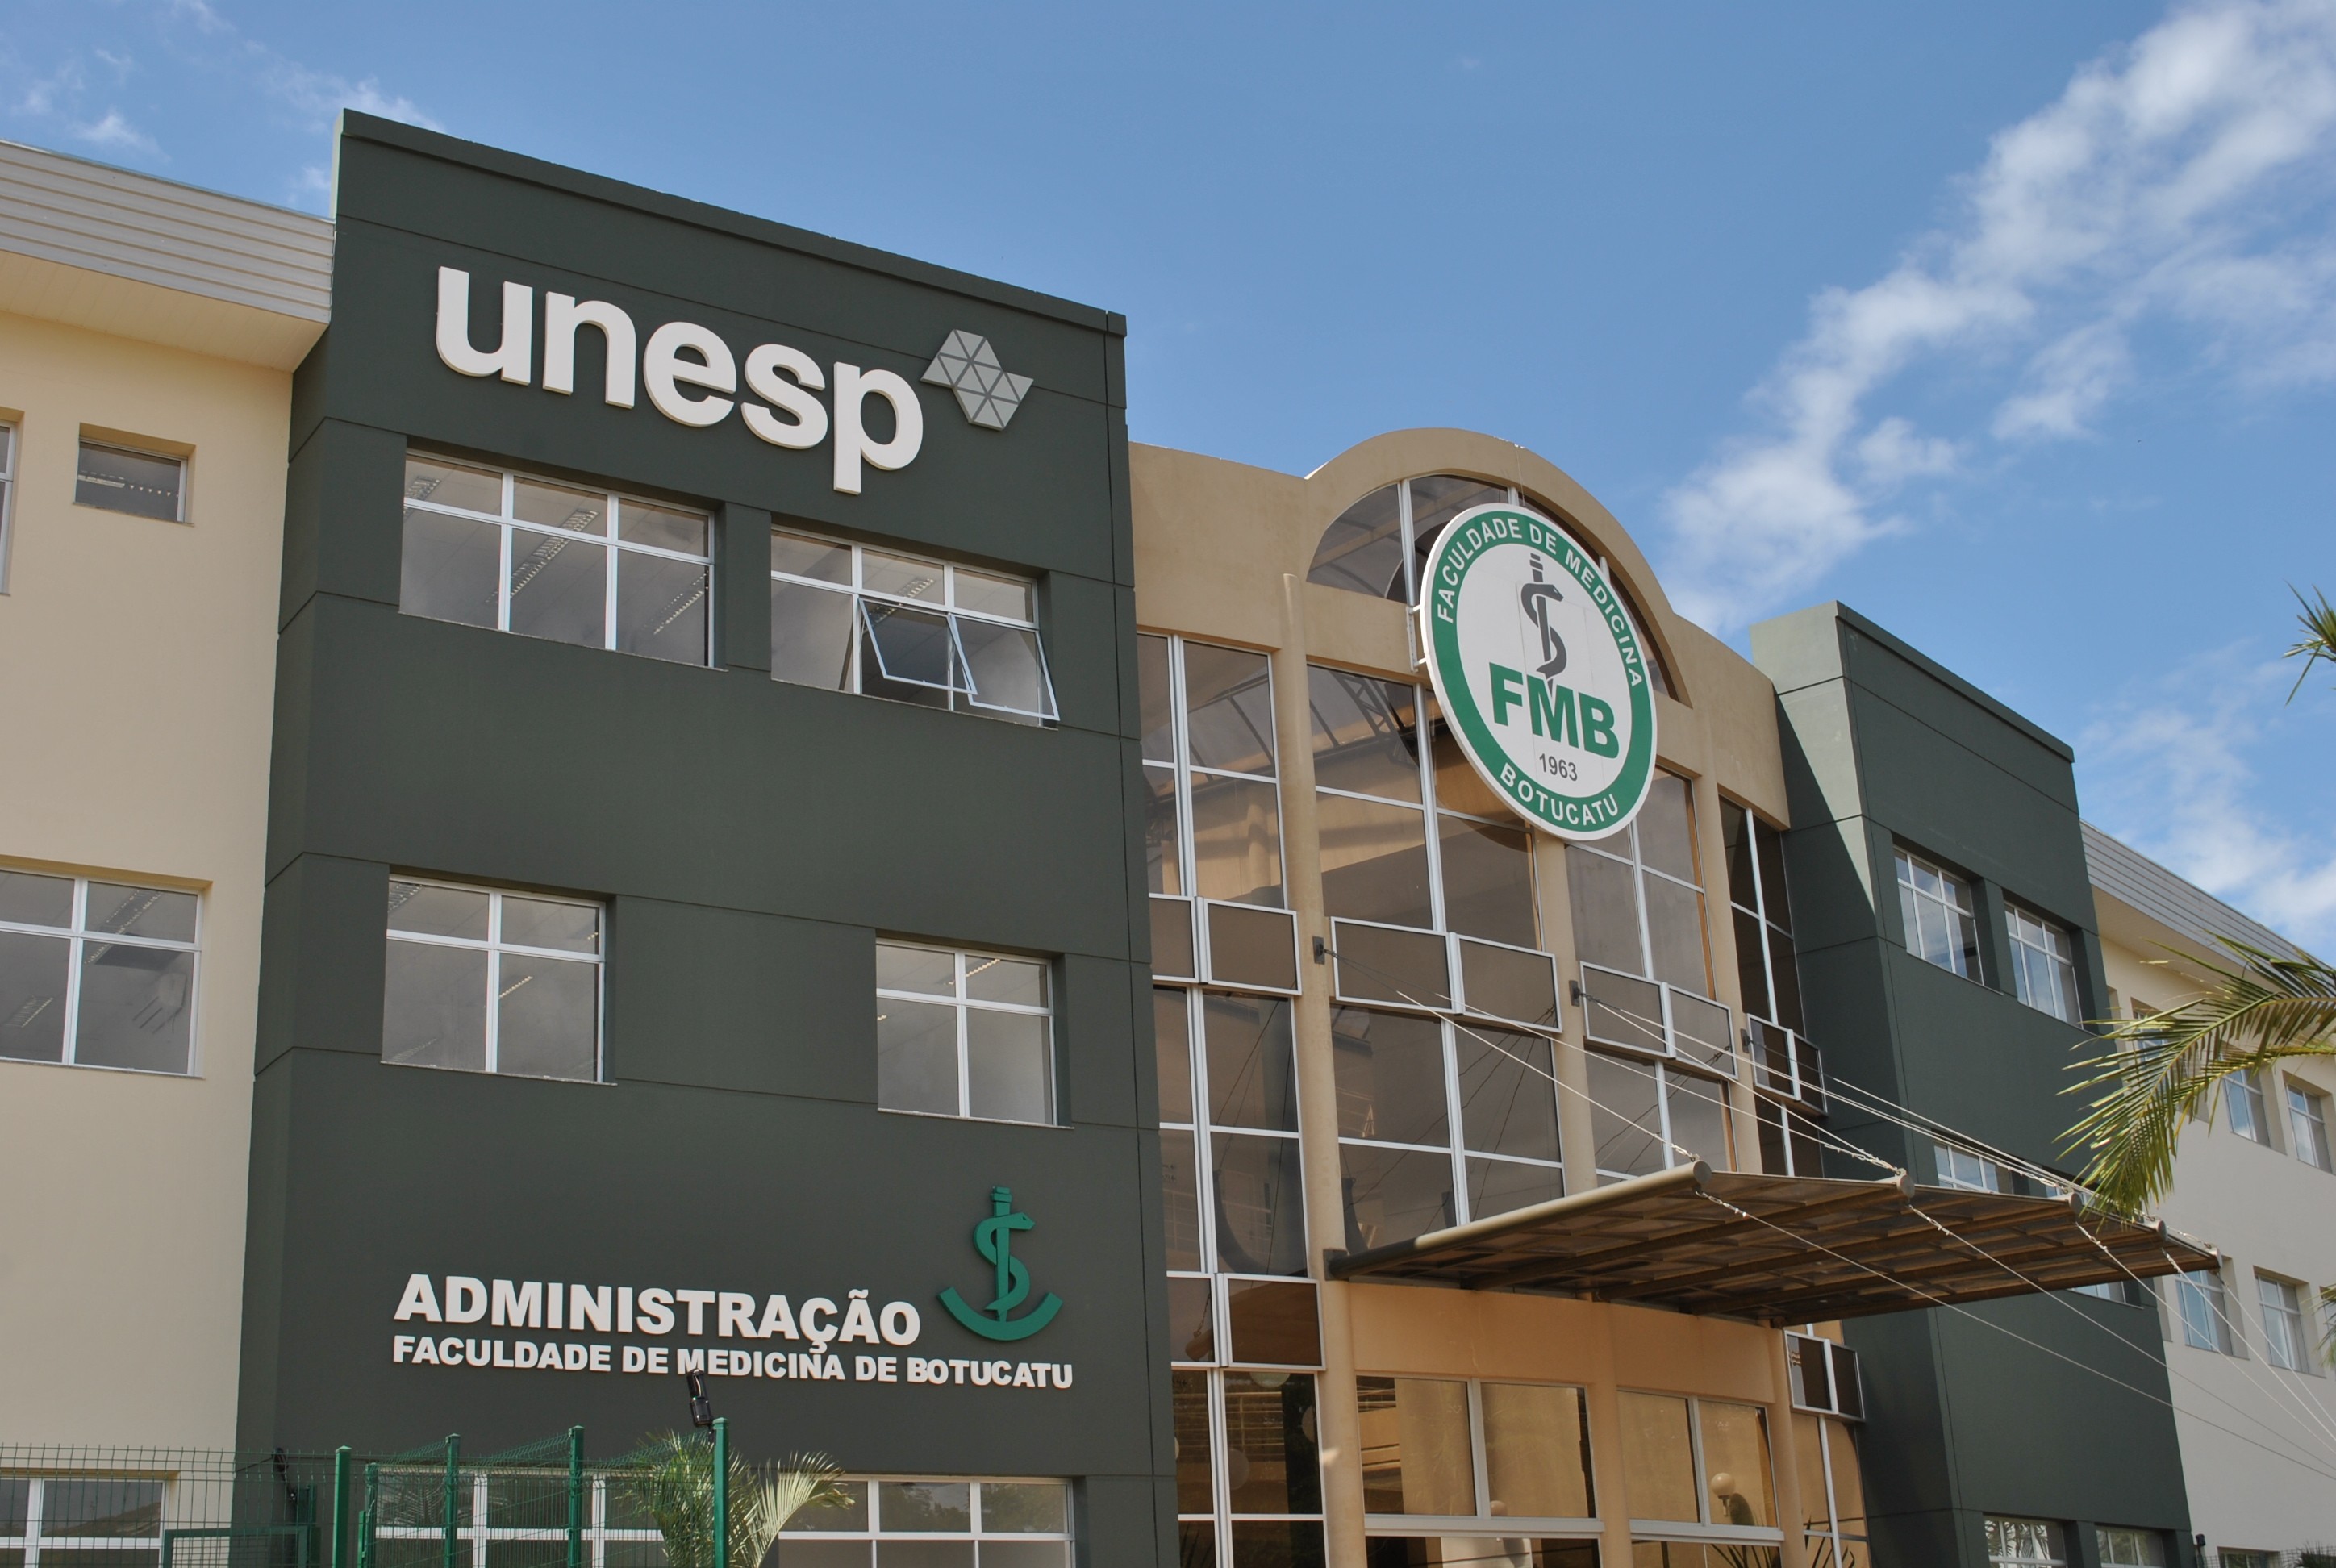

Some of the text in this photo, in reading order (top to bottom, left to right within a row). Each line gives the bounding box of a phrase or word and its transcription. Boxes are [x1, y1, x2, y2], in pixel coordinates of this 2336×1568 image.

[436, 266, 923, 494] unesp
[1437, 518, 1643, 687] FACULDADE DE MEDICINA
[1489, 661, 1620, 759] FMB
[1500, 762, 1619, 825] BOTUCATU
[1539, 753, 1579, 782] 1963
[394, 1274, 921, 1353] ADMINISTRAÇÃO
[393, 1335, 1074, 1389] FACULDADE DE MEDICINA DE BOTUCATU
